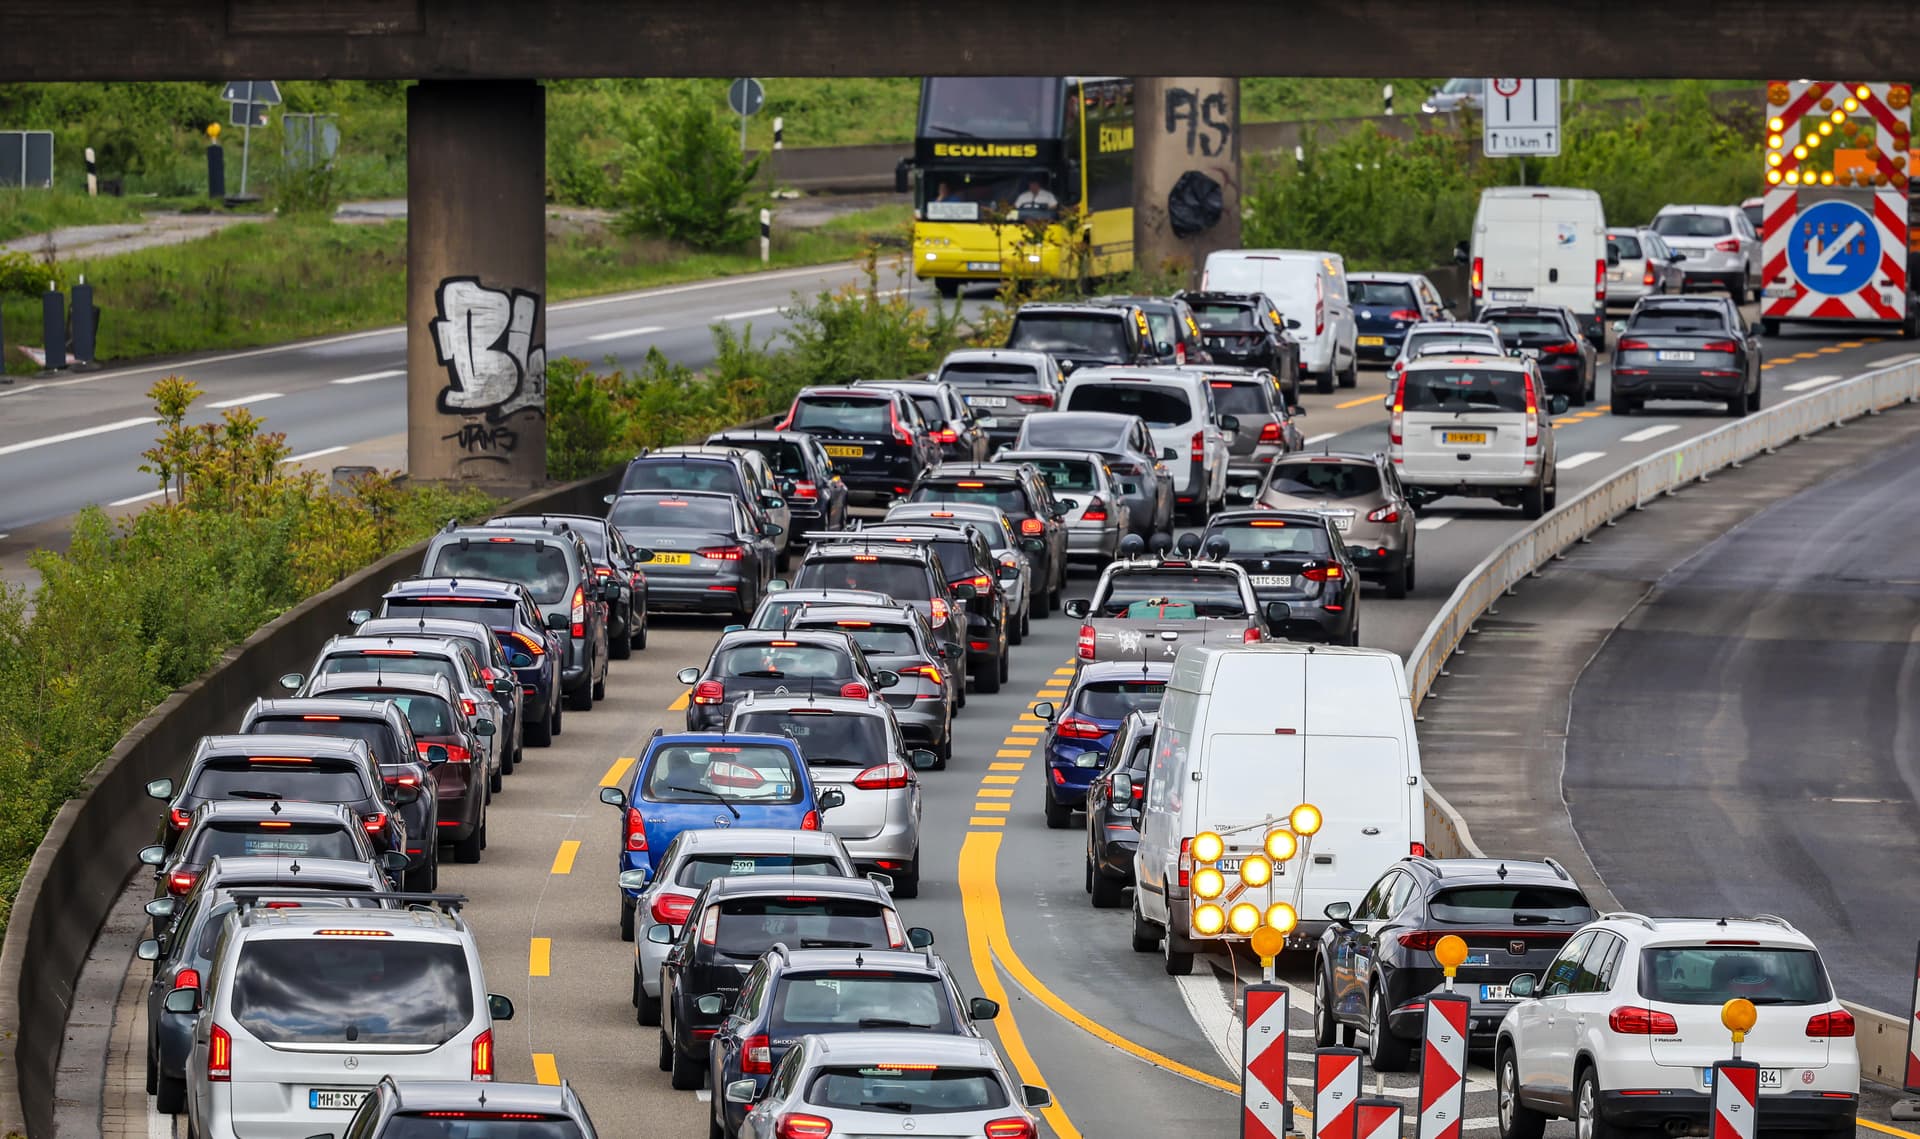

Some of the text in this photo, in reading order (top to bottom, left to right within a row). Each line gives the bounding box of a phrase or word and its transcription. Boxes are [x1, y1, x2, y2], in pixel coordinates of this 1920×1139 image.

[1520, 136, 1540, 148] km
[934, 144, 1038, 157] ECOLINES
[318, 1093, 357, 1107] MH SK
